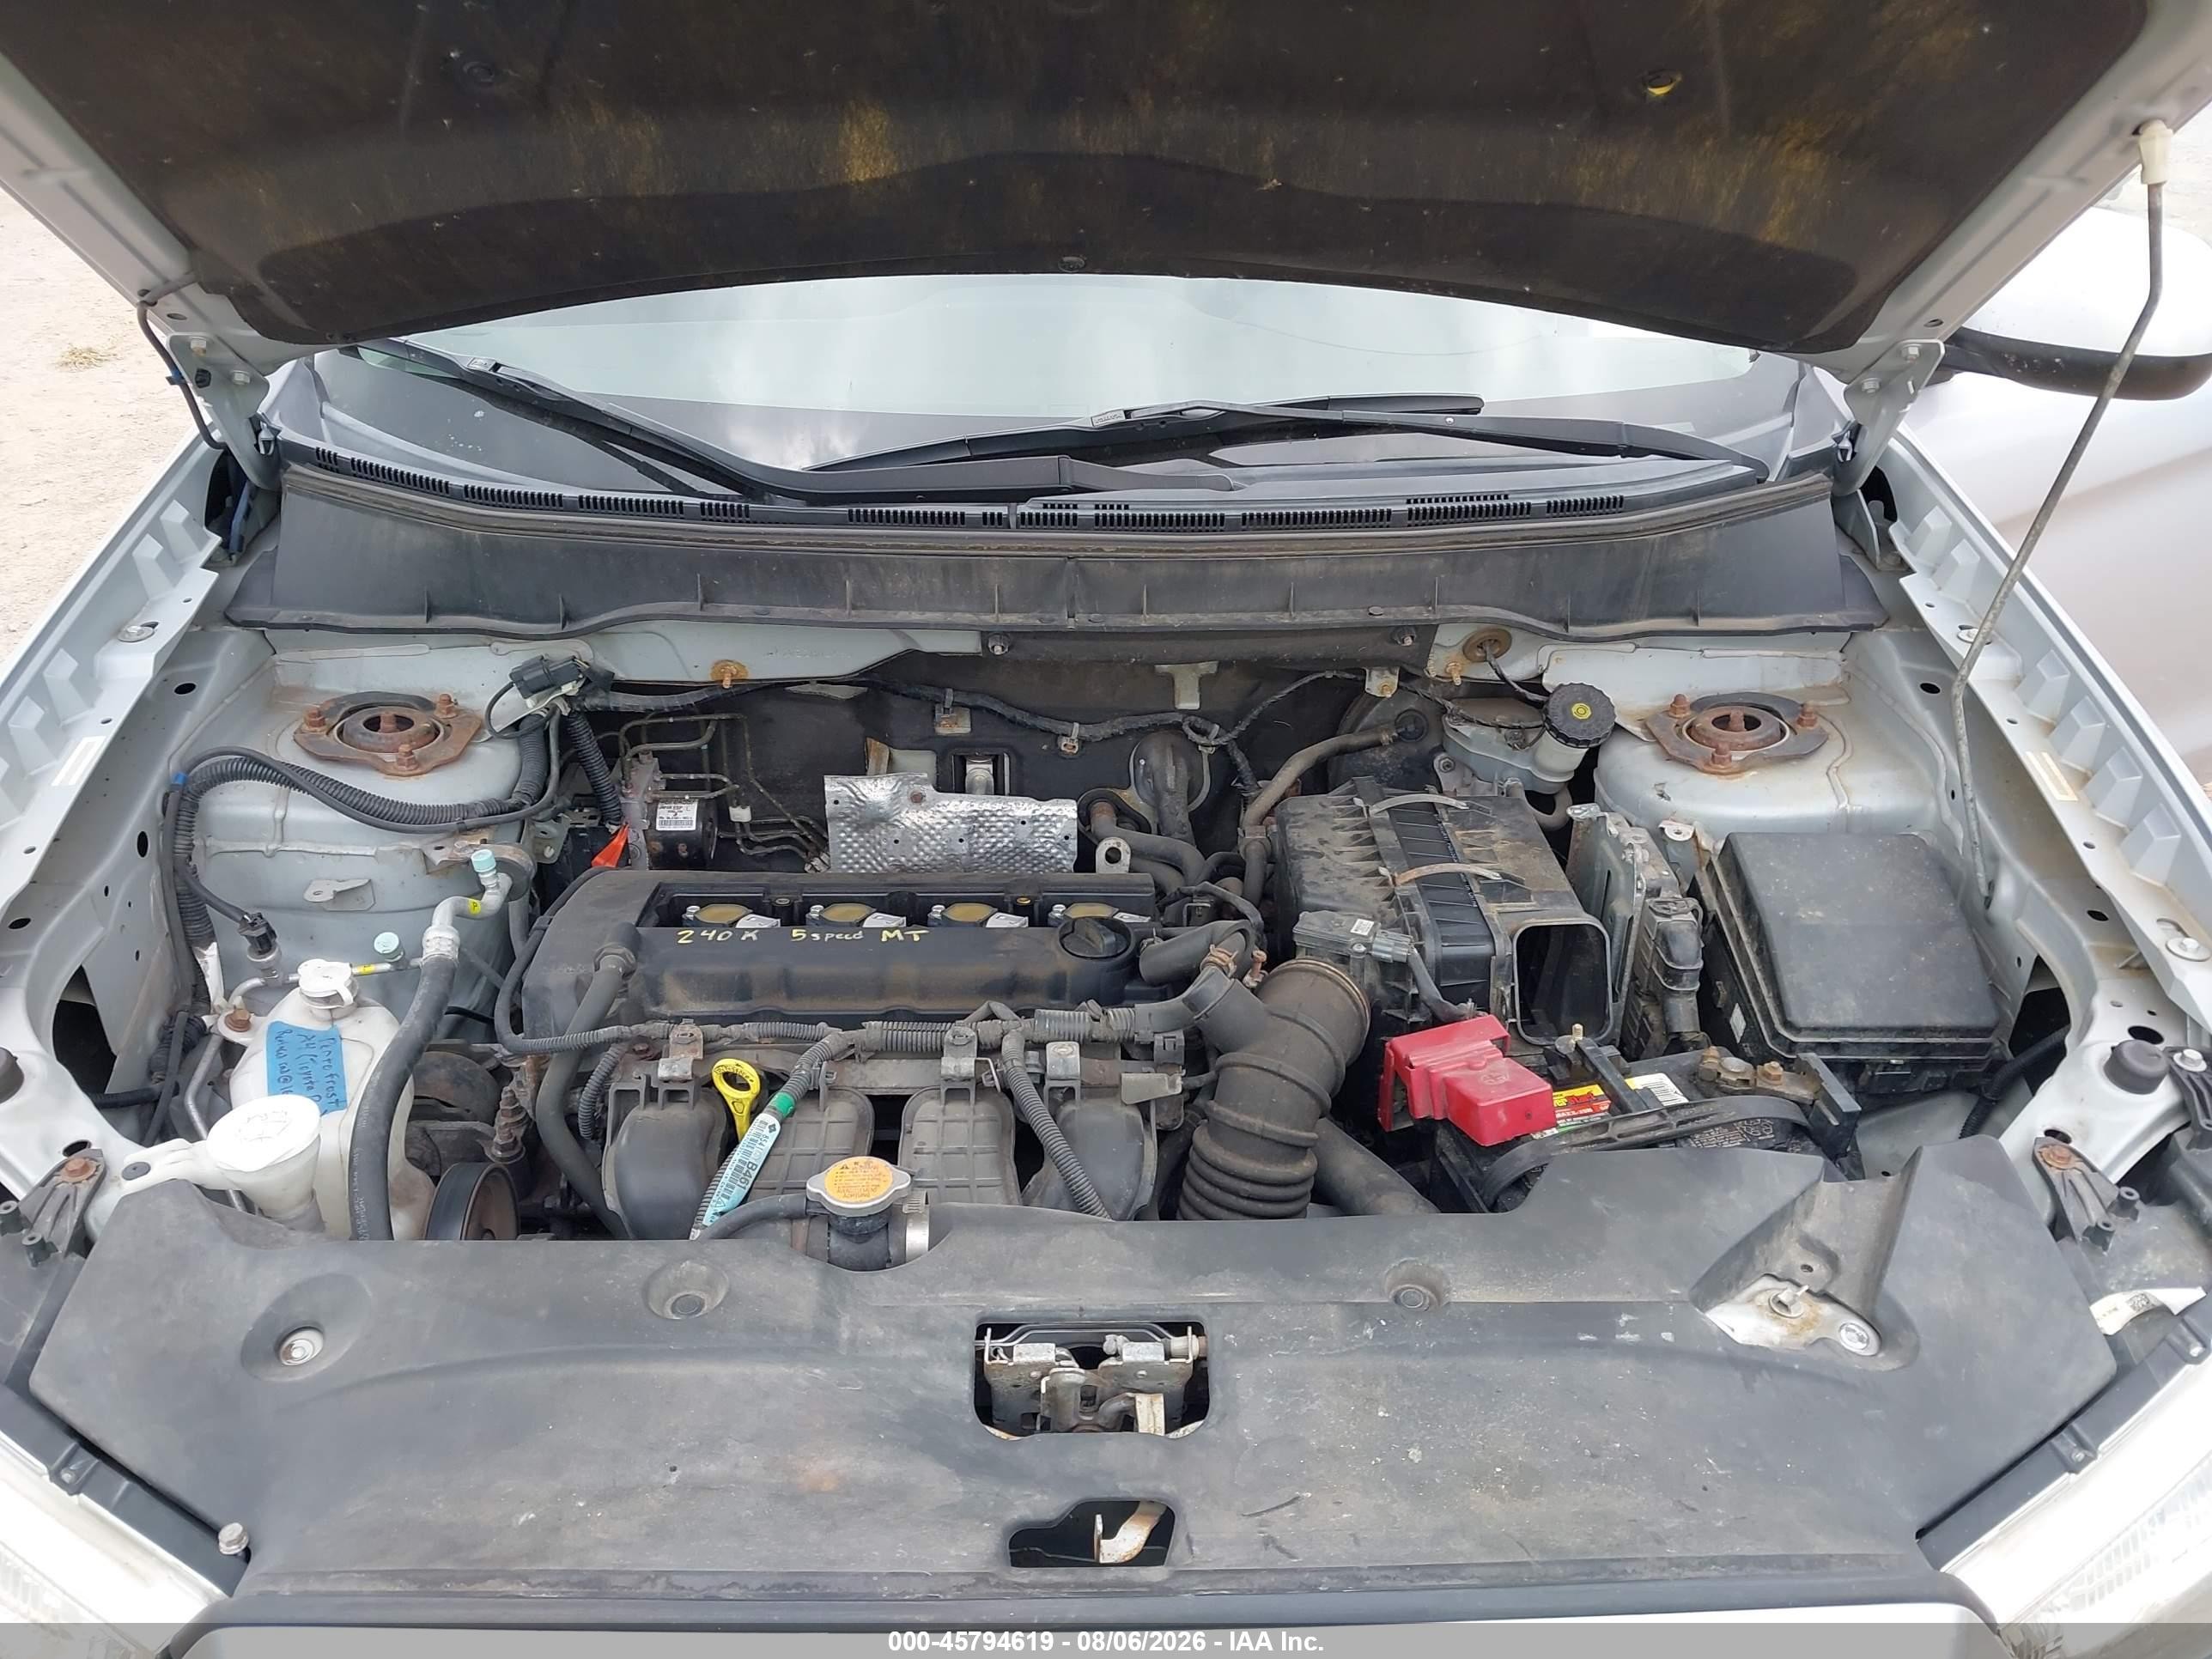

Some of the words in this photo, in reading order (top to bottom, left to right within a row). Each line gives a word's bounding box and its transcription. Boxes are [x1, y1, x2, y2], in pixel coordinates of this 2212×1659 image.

[677, 929, 733, 944] 240
[880, 929, 930, 942] MT
[738, 1160, 759, 1191] B461
